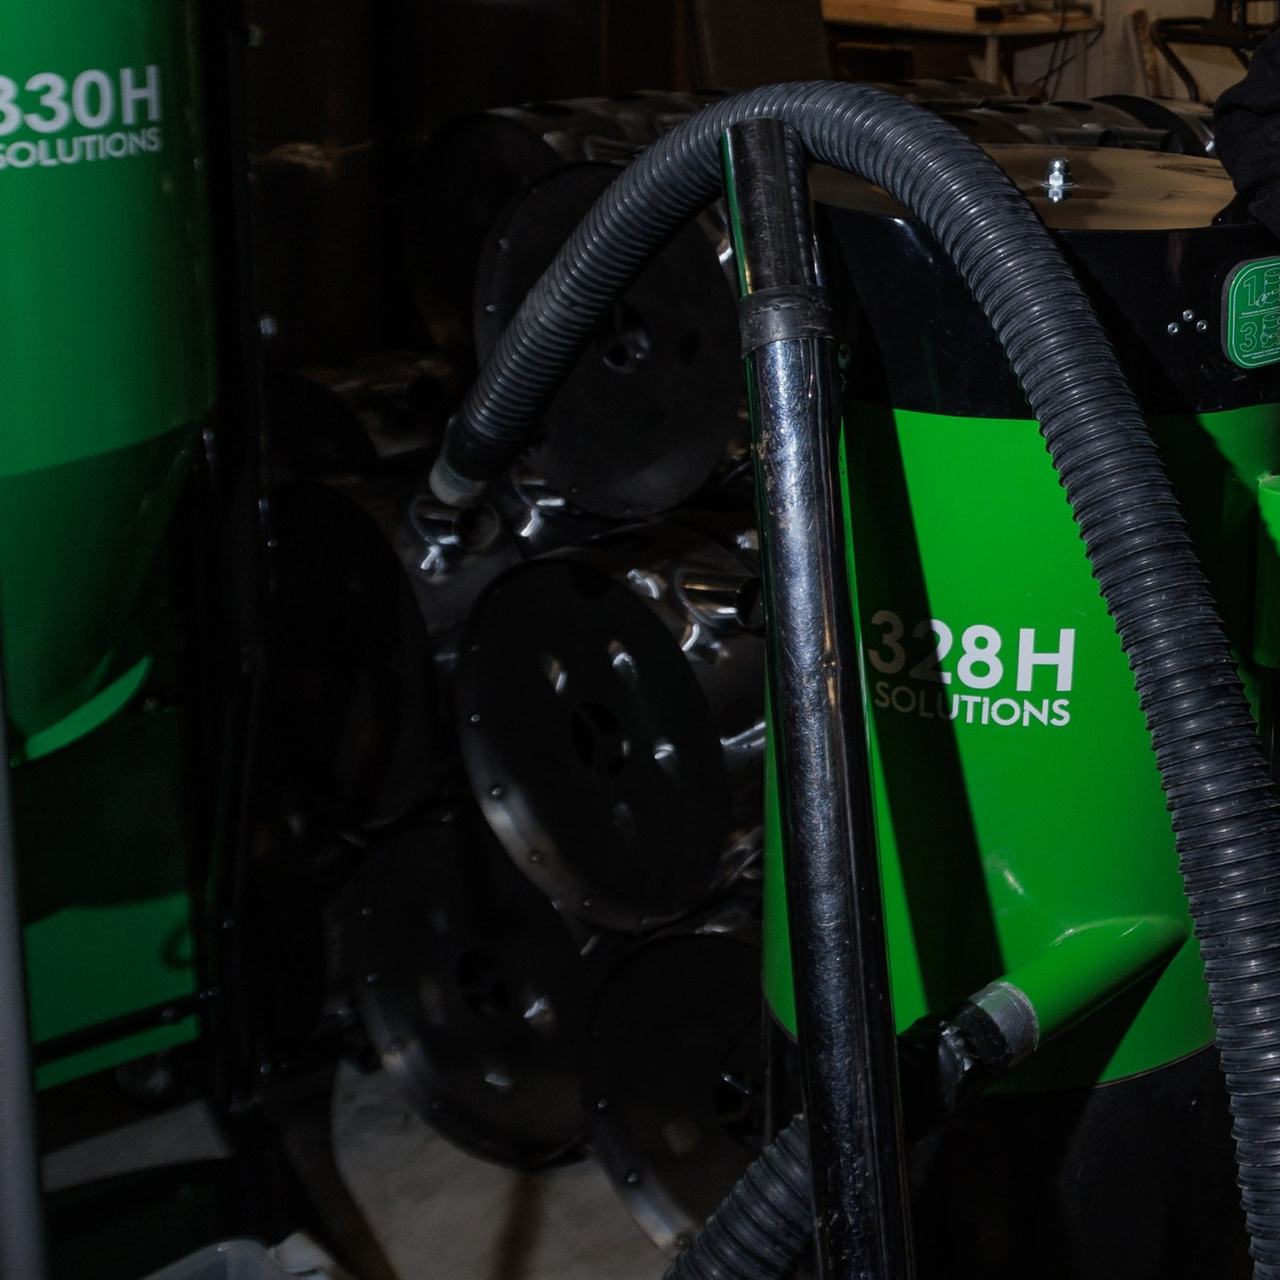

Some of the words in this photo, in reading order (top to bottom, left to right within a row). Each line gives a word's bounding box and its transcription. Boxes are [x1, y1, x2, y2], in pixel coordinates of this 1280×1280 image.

[1243, 275, 1257, 306] 1
[1240, 321, 1258, 352] 3
[867, 610, 1075, 691] 328H
[874, 681, 1071, 726] SOLUTIONS
